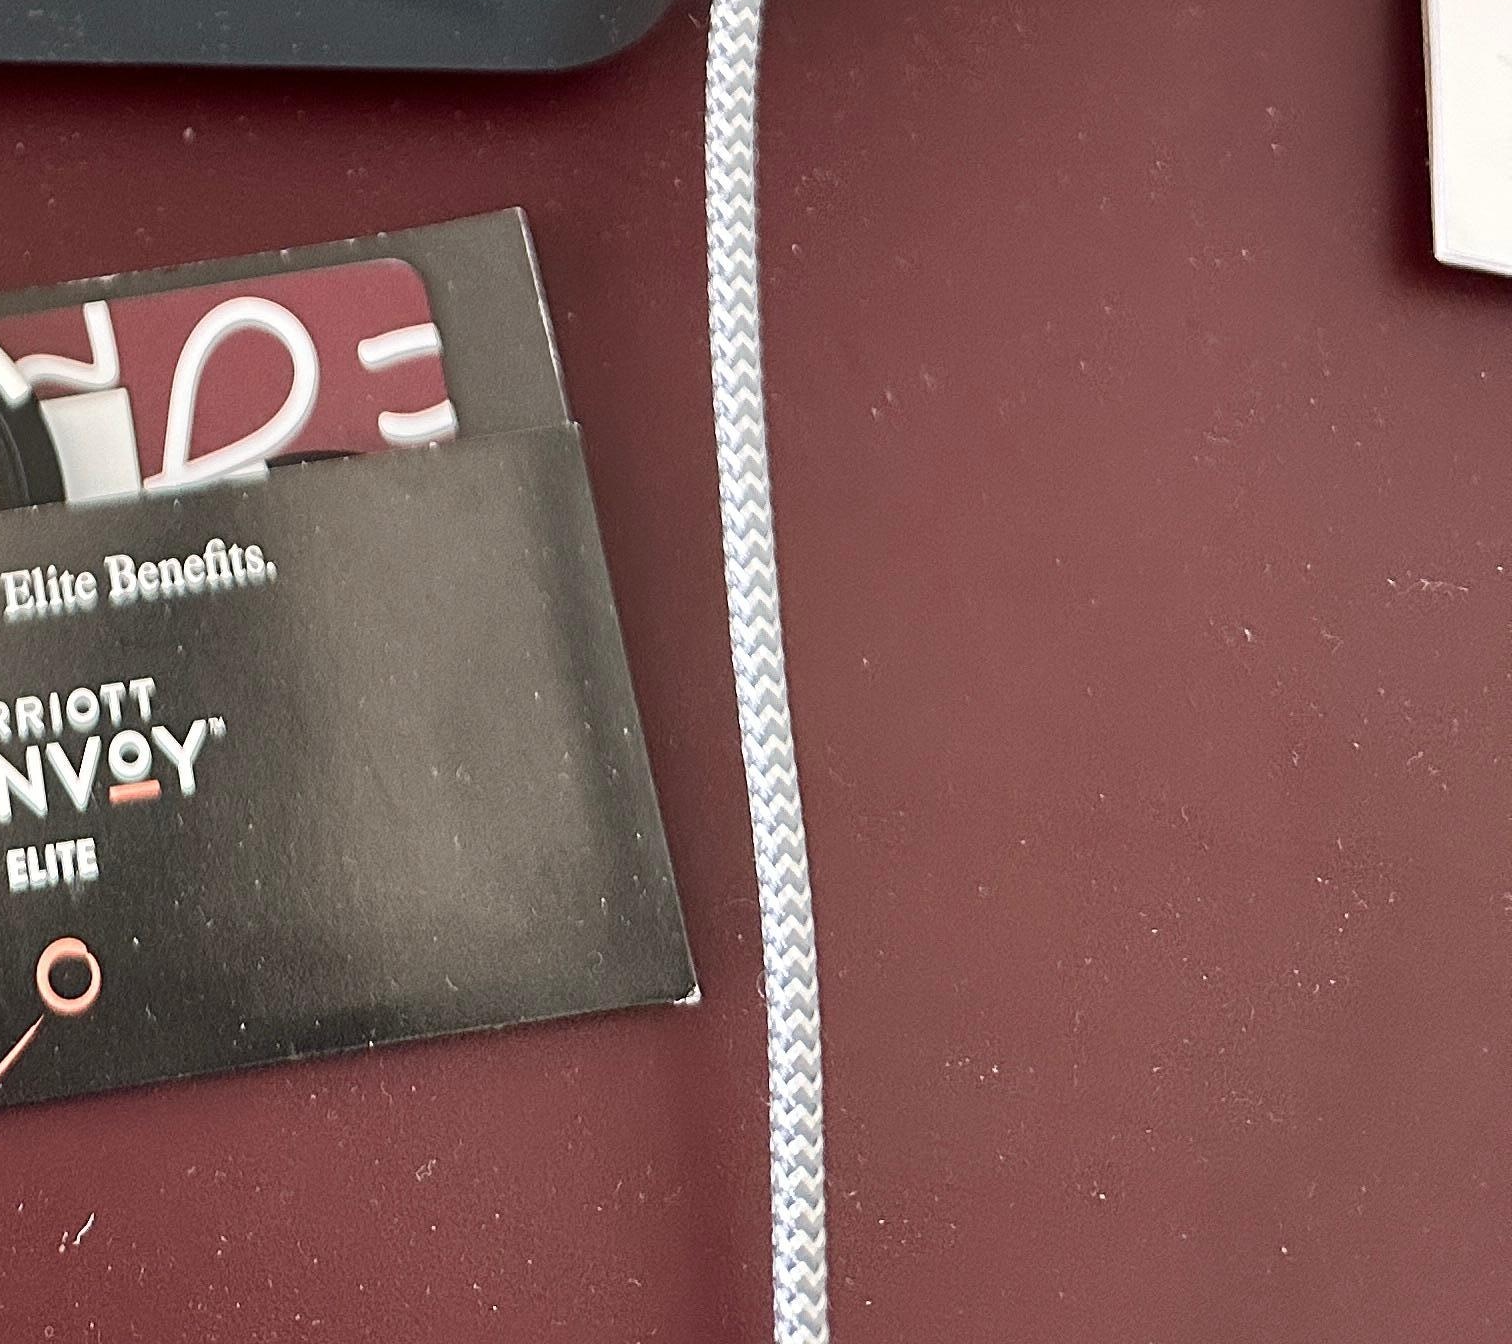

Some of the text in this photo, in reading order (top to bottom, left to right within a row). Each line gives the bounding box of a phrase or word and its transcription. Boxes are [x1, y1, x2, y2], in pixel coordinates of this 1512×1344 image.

[0, 564, 99, 620] Elite
[104, 537, 278, 605] Benefits.
[5, 837, 100, 892] ELITE
